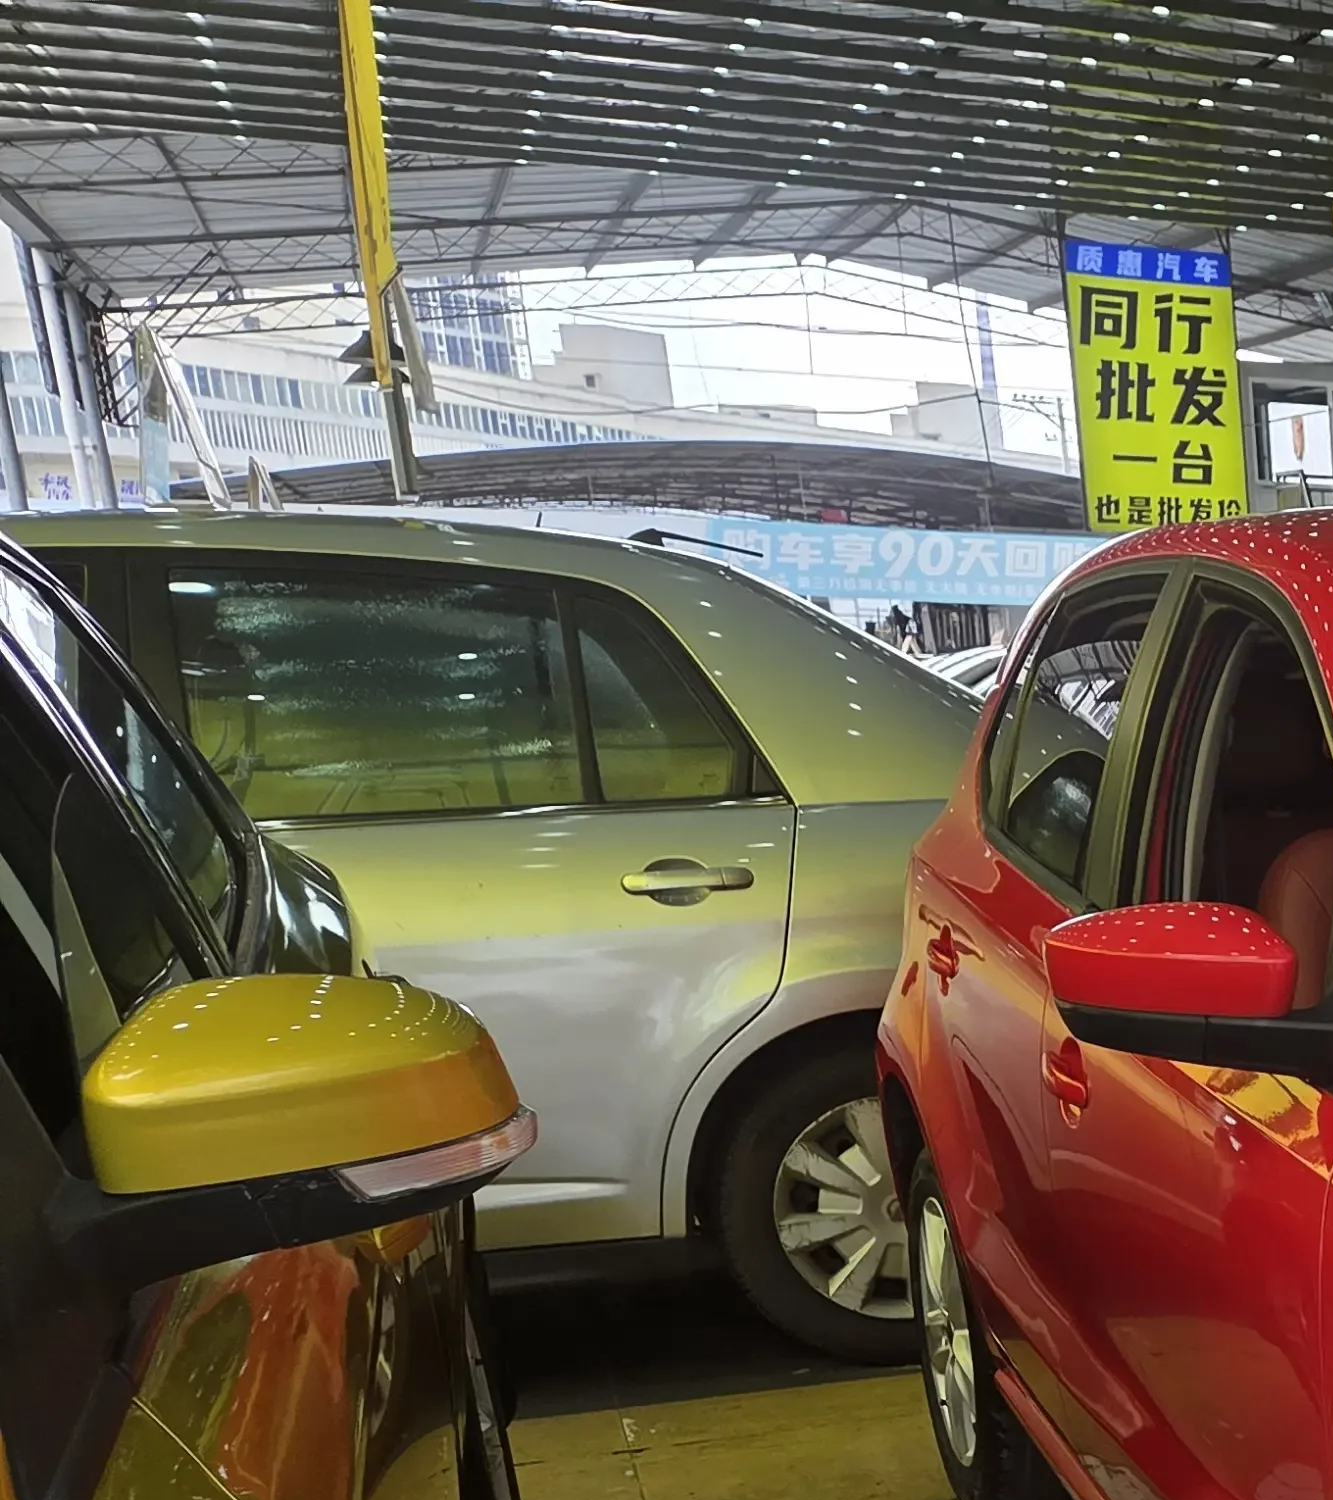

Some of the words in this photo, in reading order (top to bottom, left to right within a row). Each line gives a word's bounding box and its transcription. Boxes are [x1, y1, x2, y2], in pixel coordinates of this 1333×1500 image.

[1079, 285, 1213, 354] 同行
[1096, 359, 1227, 428] 批发
[1112, 440, 1213, 485] 一台
